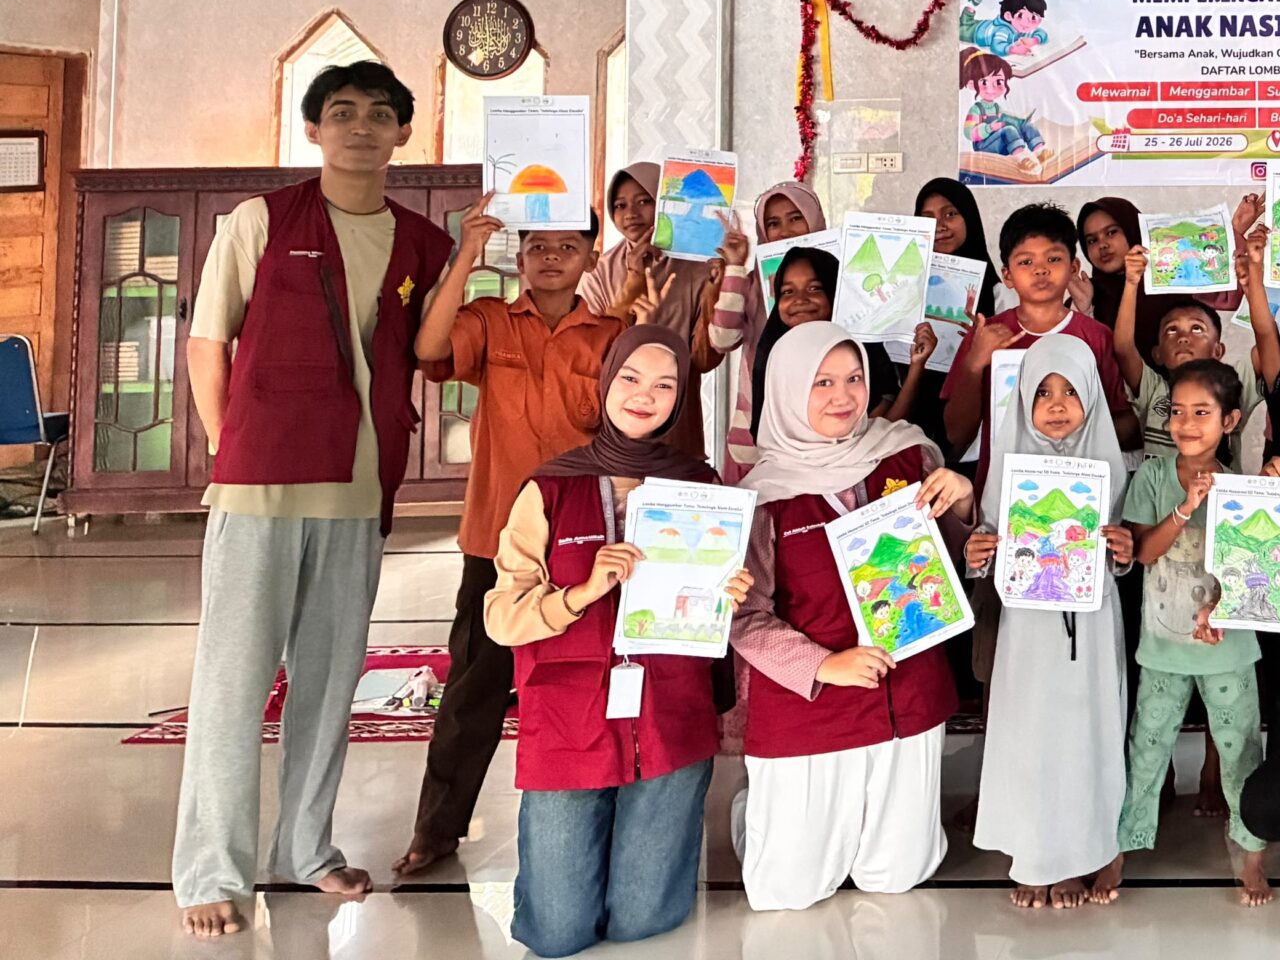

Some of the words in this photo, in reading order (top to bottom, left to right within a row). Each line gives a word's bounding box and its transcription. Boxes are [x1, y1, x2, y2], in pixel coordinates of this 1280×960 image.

[472, 5, 482, 17] 11
[486, 2, 498, 14] 12
[503, 7, 508, 18] 1
[460, 15, 471, 27] 10
[512, 18, 519, 29] 2
[1135, 15, 1214, 38] ANAK
[456, 29, 463, 41] 9
[514, 32, 521, 43] 3
[458, 44, 466, 56] 8
[509, 47, 516, 58] 4
[1134, 48, 1185, 59] "Bersama
[1187, 48, 1218, 60] Anak,
[1220, 48, 1274, 60] Wujudkan
[482, 60, 490, 71] 6
[498, 57, 505, 68] 5
[1200, 65, 1246, 76] DAFTAR
[1089, 86, 1151, 98] Mewarnai
[1168, 85, 1251, 100] Menggambar
[1157, 113, 1183, 124] Do'a
[1185, 112, 1248, 124] Sehari-hari
[1144, 137, 1158, 147] 25
[1168, 137, 1183, 147] 26
[1185, 136, 1203, 147] Juli
[1205, 136, 1233, 147] 2026
